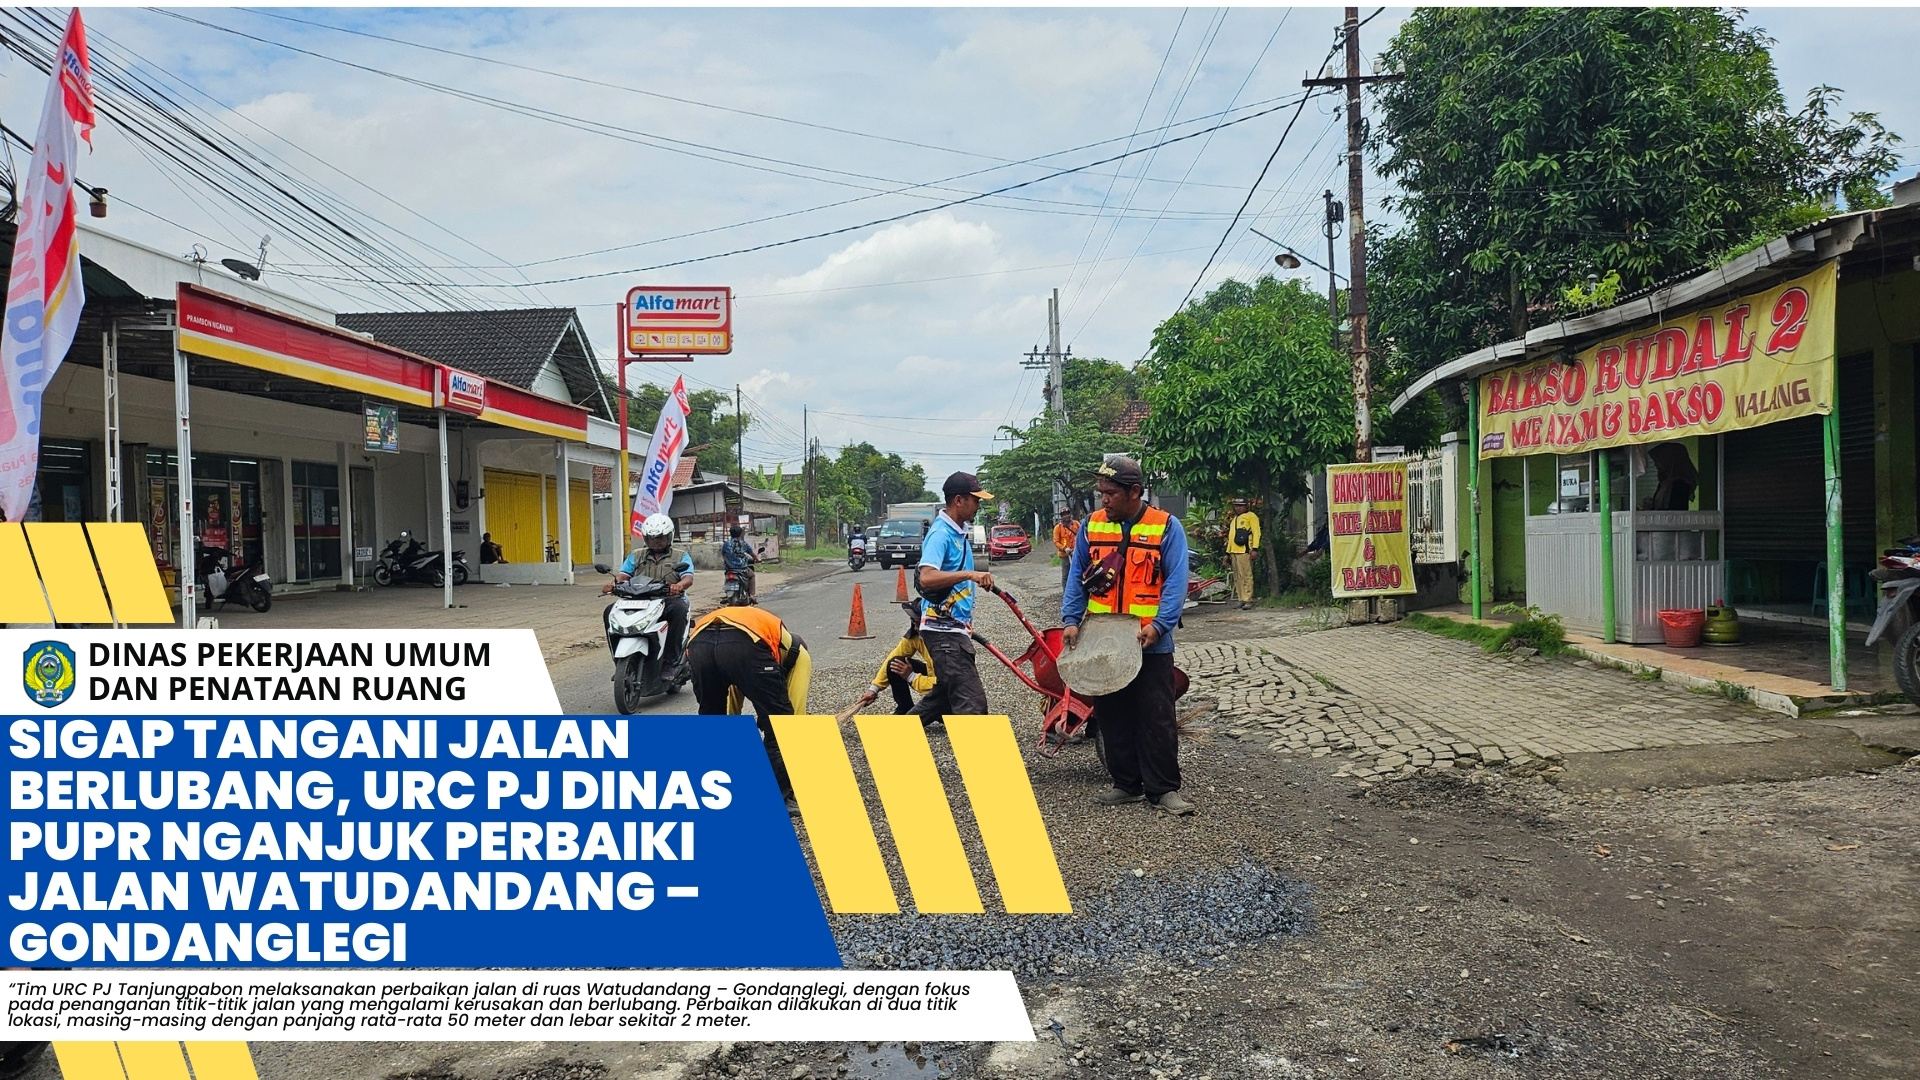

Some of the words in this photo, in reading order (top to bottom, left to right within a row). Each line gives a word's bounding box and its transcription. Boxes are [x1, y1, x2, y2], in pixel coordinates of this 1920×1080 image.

[635, 294, 721, 310] Alfamart
[186, 314, 212, 328] PRAMBON
[1487, 359, 1587, 417] BAKSO
[1593, 304, 1756, 396] RUDAL
[1766, 286, 1810, 356] 2
[452, 374, 483, 397] Alfamart
[1511, 415, 1543, 449] MIE
[1545, 404, 1600, 447] AYAM
[1628, 381, 1725, 436] BAKSO
[1333, 471, 1365, 504] BAKSO
[1365, 471, 1395, 503] RUDAL
[1394, 471, 1403, 501] 2
[1563, 478, 1578, 487] BUKA
[1332, 511, 1363, 537] MIE
[1365, 508, 1403, 534] AYAM
[1363, 538, 1376, 562] &
[1342, 564, 1402, 591] BAKSO
